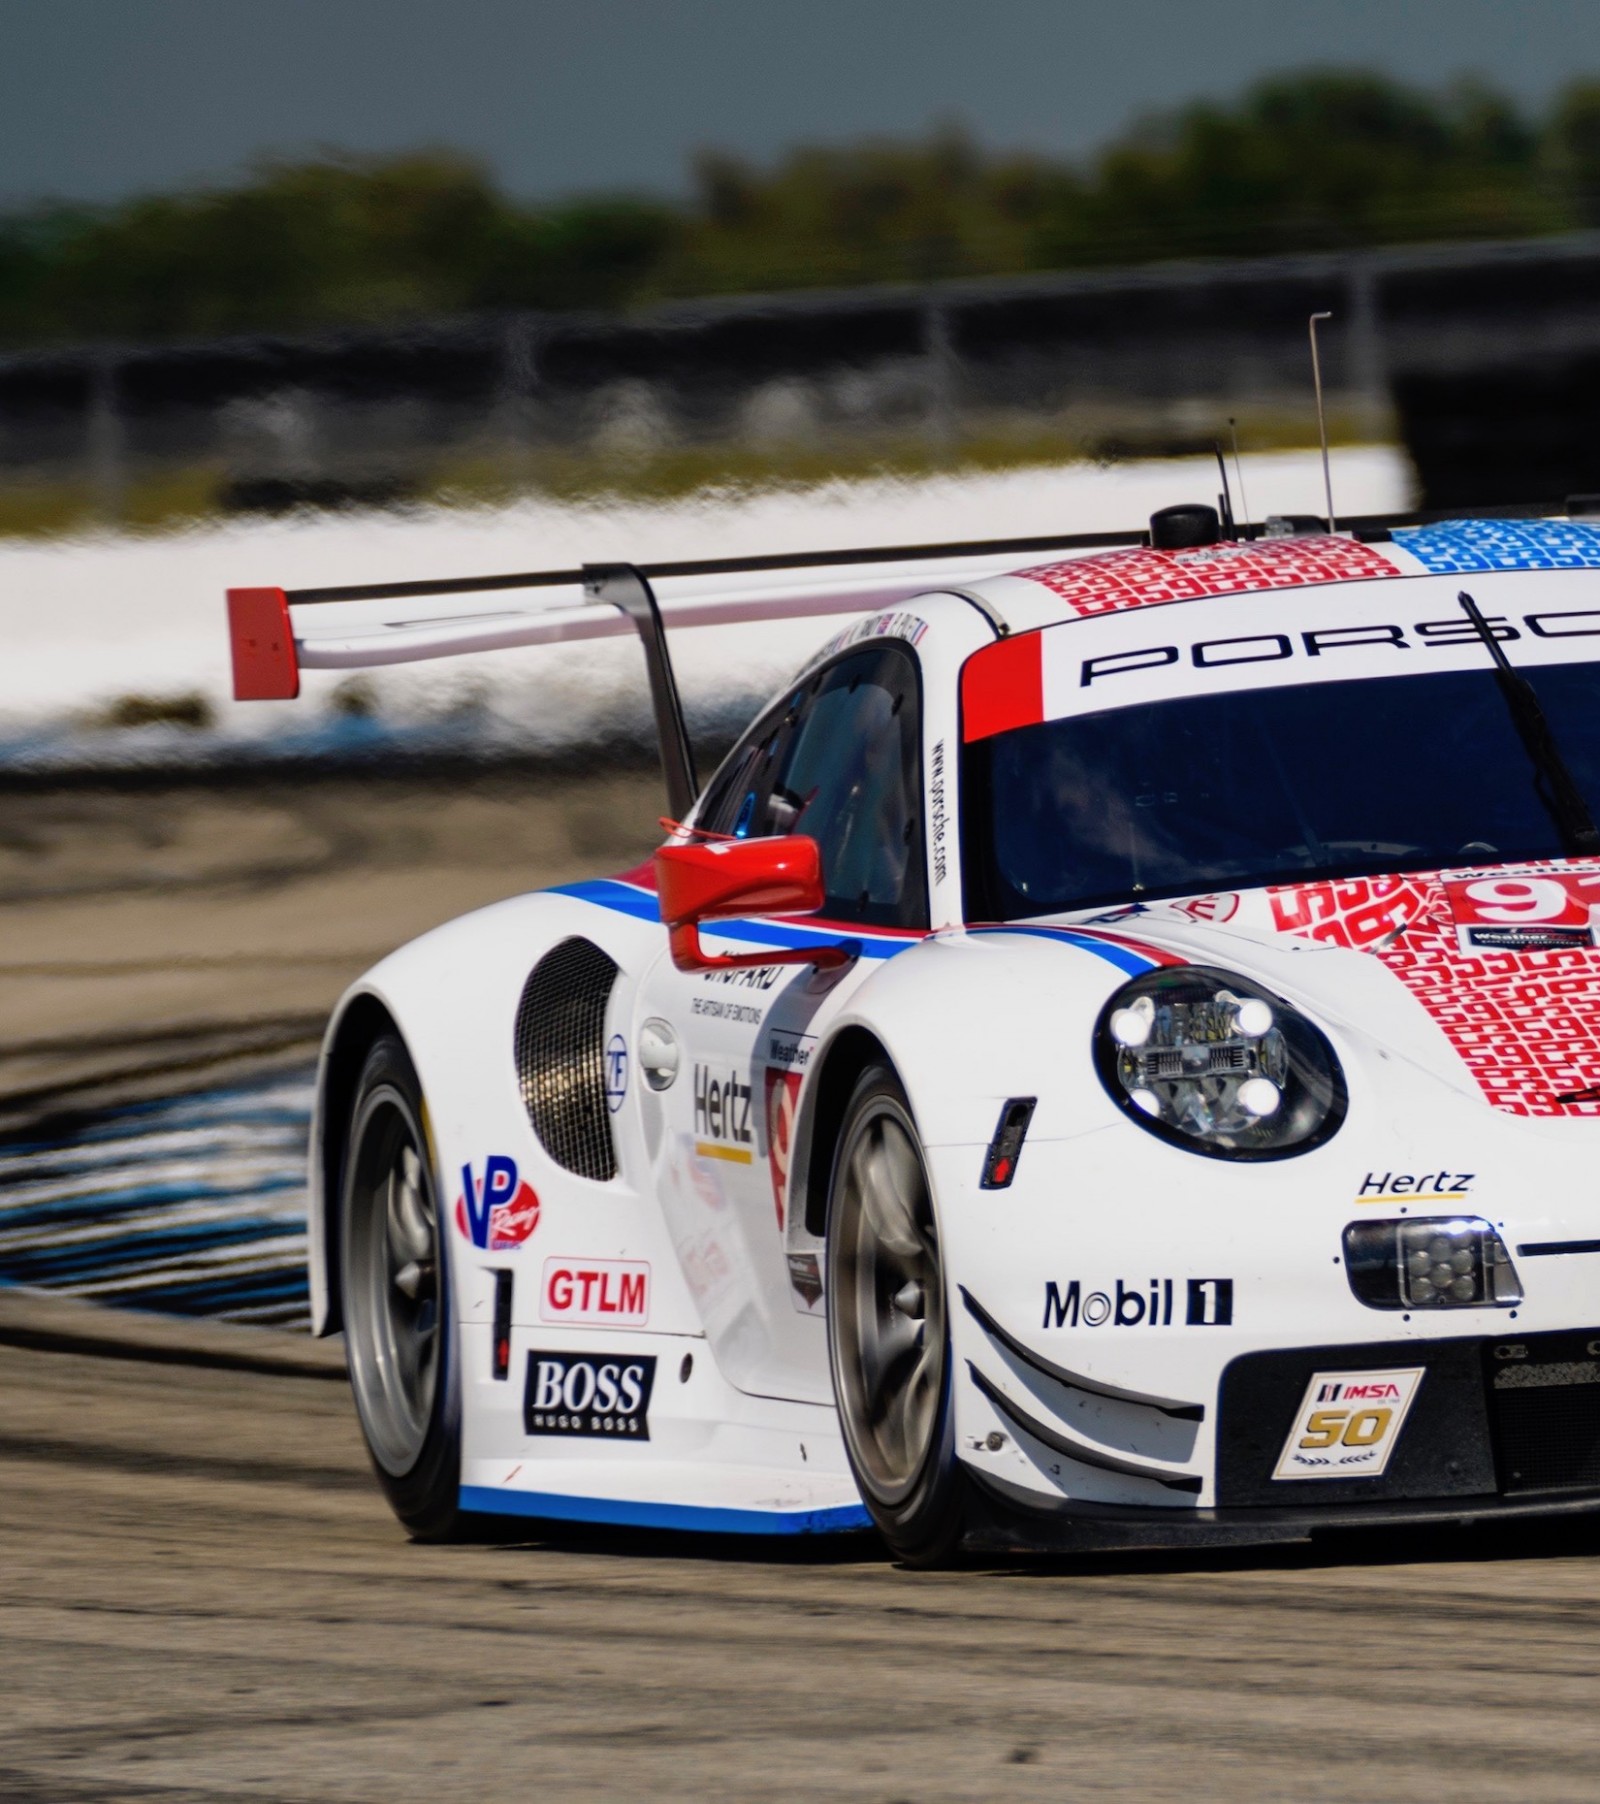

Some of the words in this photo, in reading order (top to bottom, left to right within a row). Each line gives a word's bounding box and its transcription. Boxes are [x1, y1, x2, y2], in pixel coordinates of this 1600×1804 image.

[931, 739, 950, 887] www.porsche.com
[769, 1038, 815, 1066] Weather
[694, 1064, 752, 1142] Hertz
[462, 1155, 517, 1249] VP
[1358, 1170, 1476, 1196] Hertz
[547, 1269, 645, 1315] GTLM
[1043, 1279, 1173, 1329] Mobil
[532, 1361, 644, 1414] BOSS
[1343, 1384, 1399, 1400] IMSA
[533, 1414, 582, 1430] HUGO
[591, 1416, 639, 1432] BOSS
[1299, 1408, 1393, 1449] 50
